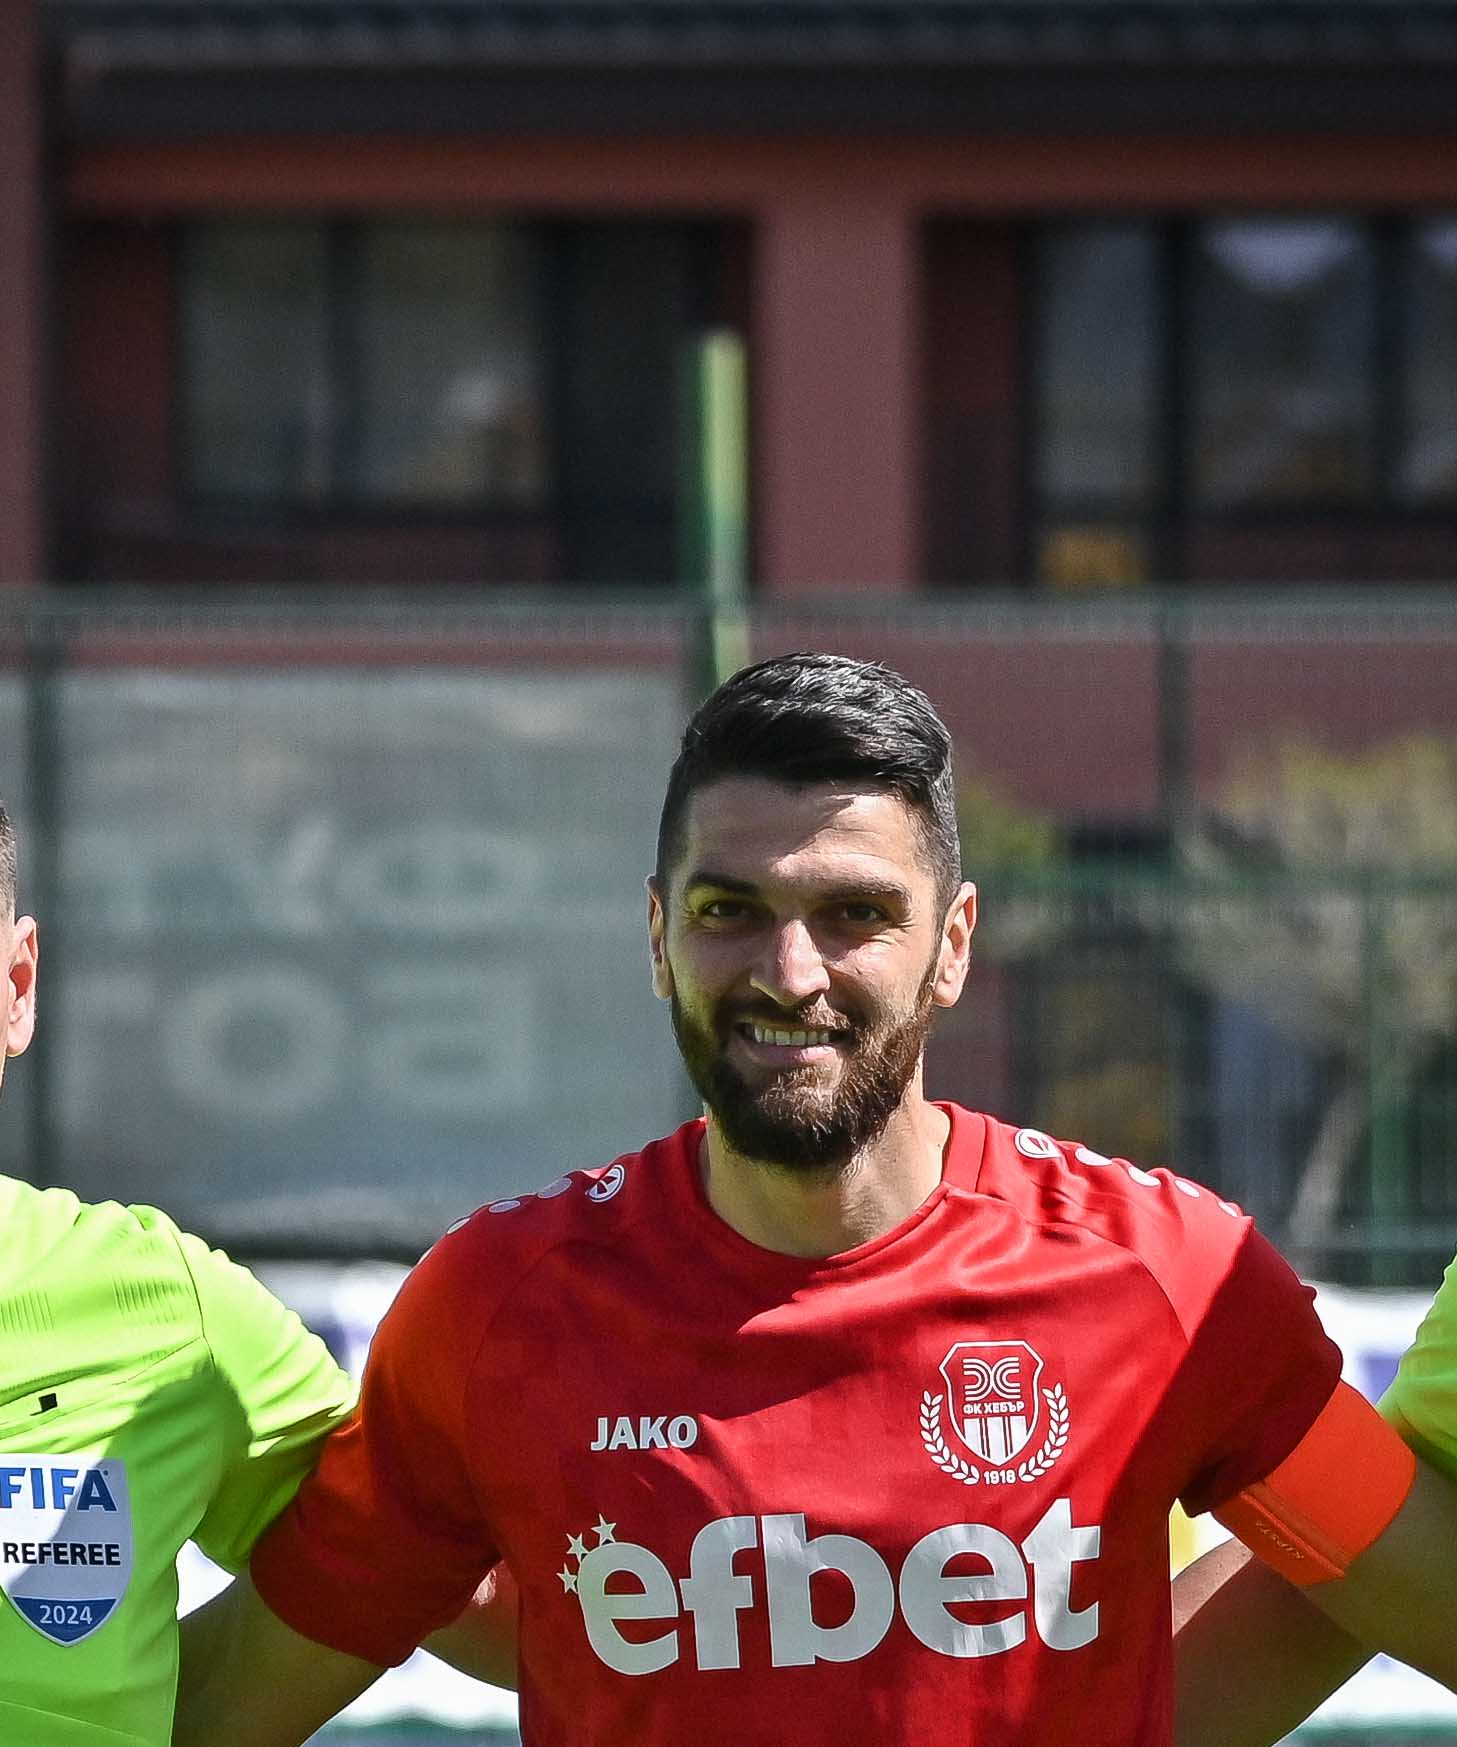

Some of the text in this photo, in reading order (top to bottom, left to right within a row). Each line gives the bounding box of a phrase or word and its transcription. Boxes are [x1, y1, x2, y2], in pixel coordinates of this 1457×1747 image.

[963, 1401, 1025, 1415] ФК ХЕБЪР
[591, 1415, 698, 1452] JAKO
[983, 1470, 1017, 1485] 1918
[2, 1542, 121, 1566] REFEREE
[576, 1498, 1101, 1676] efbet
[39, 1604, 93, 1625] 2024
